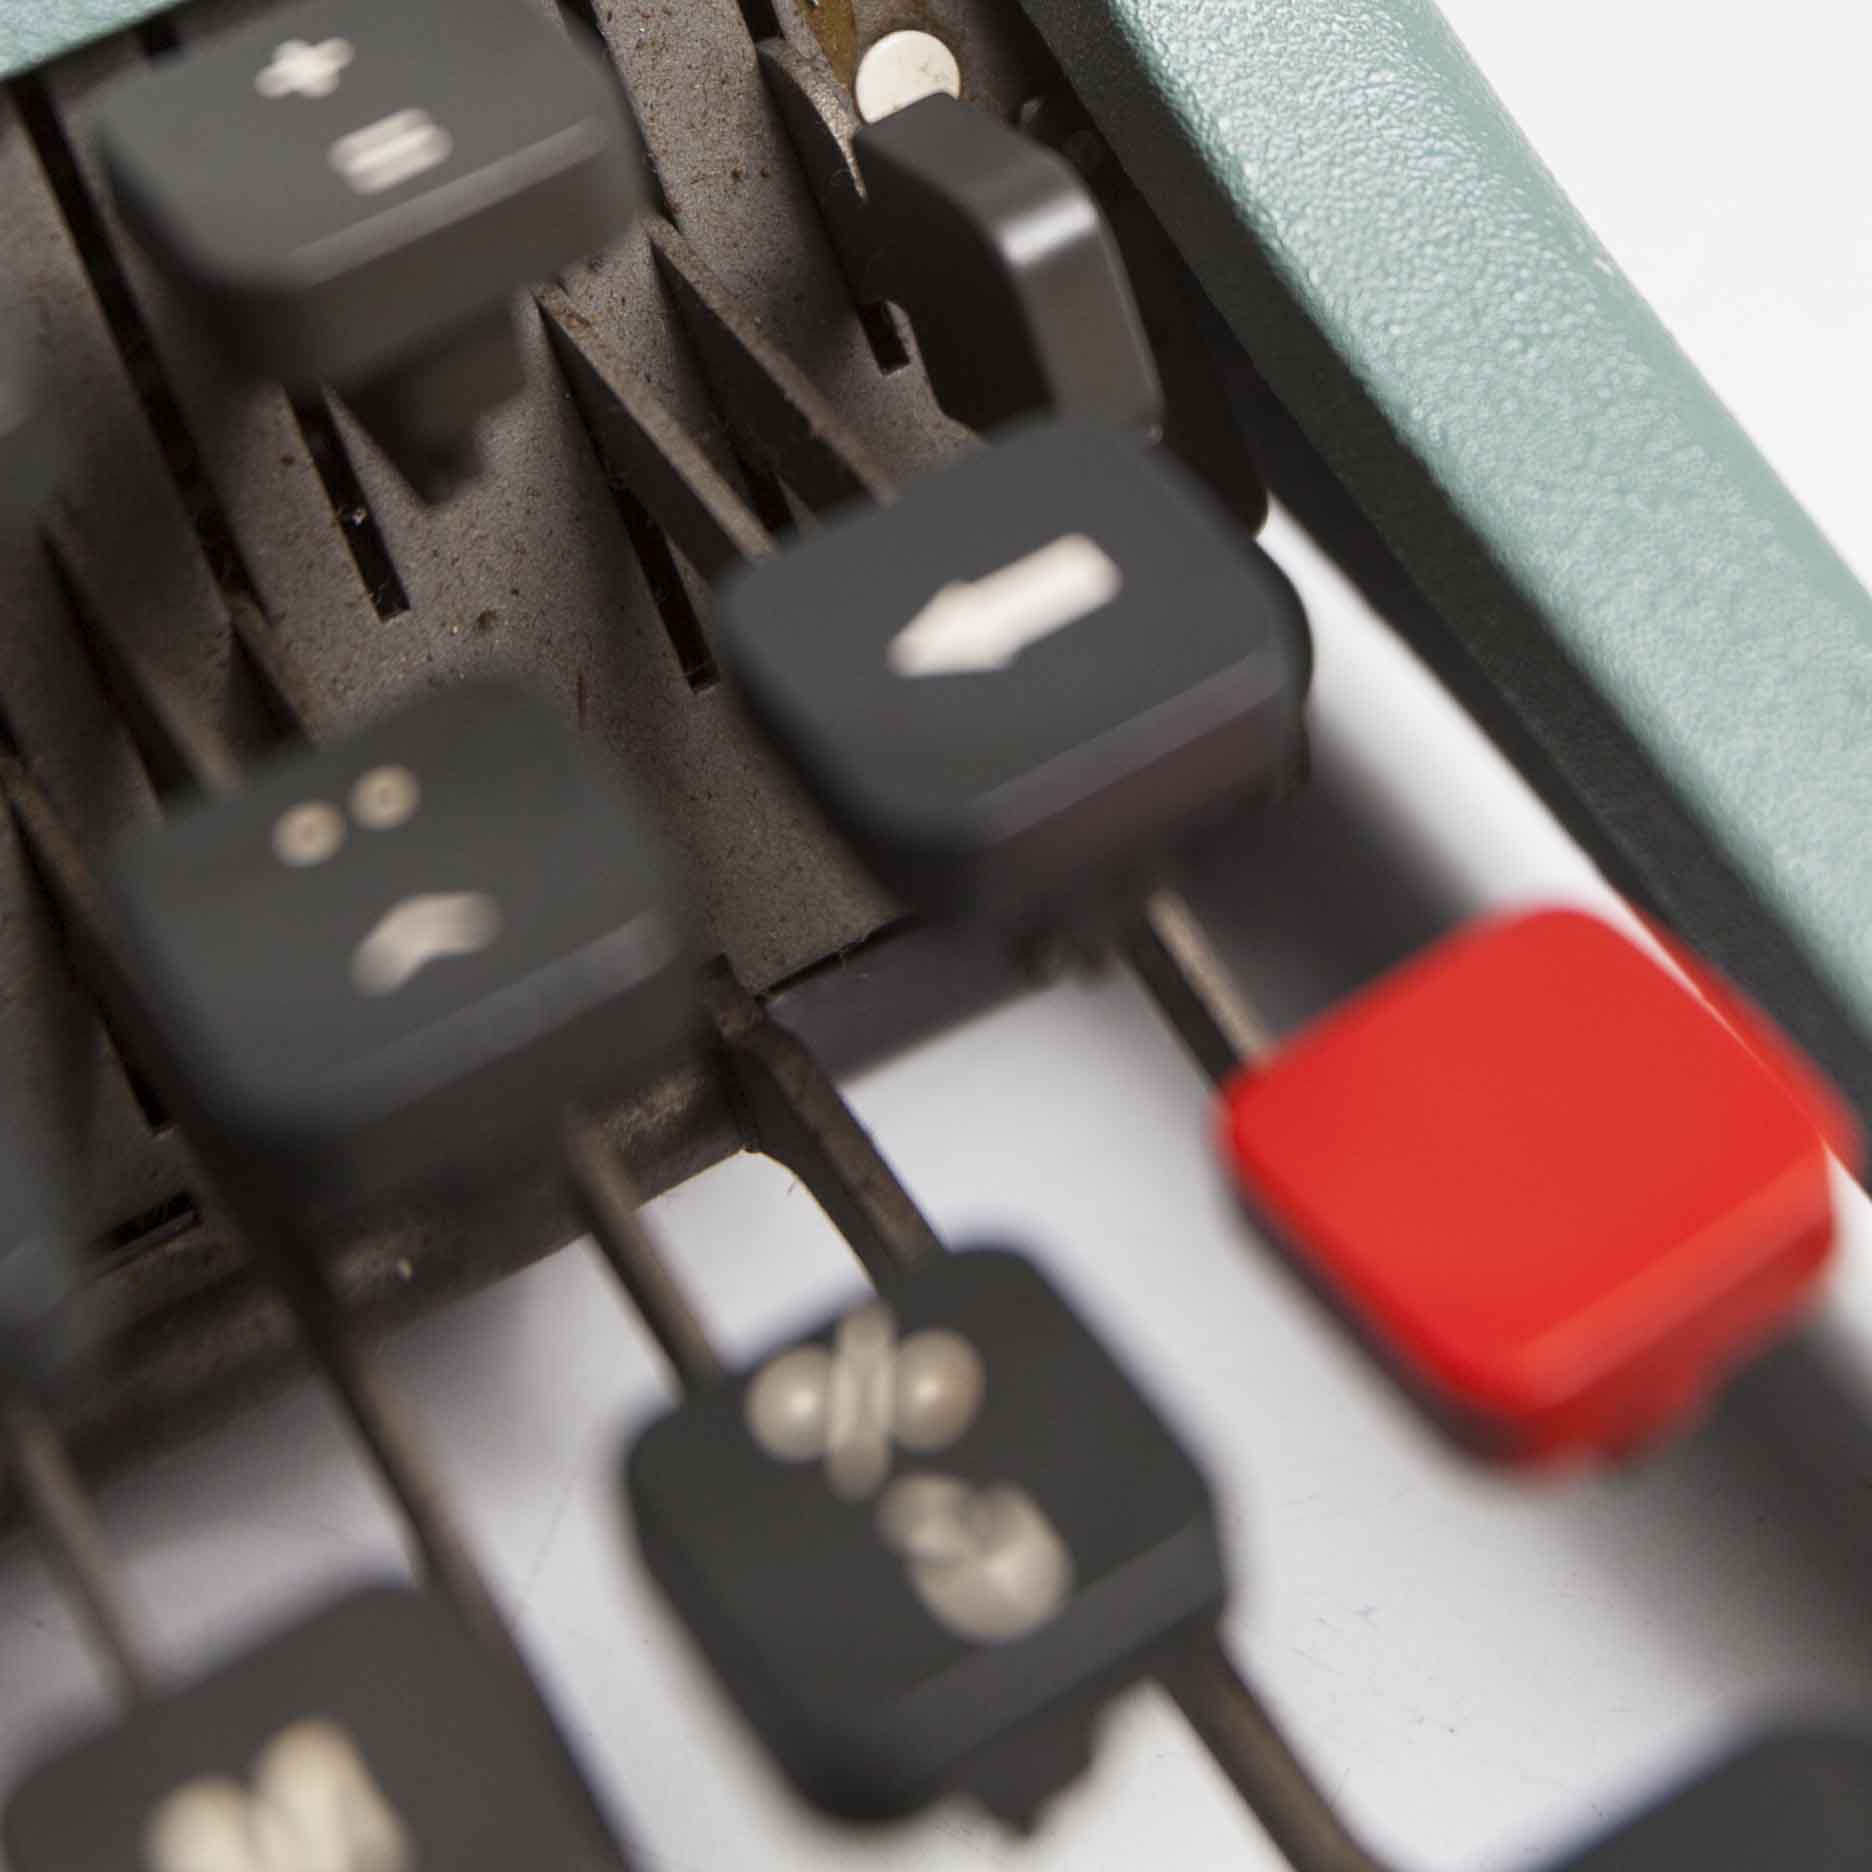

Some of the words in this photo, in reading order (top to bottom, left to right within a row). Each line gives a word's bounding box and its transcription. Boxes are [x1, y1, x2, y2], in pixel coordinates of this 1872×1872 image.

[253, 36, 355, 99] +
[328, 107, 454, 196] =
[742, 1298, 986, 1498] %
